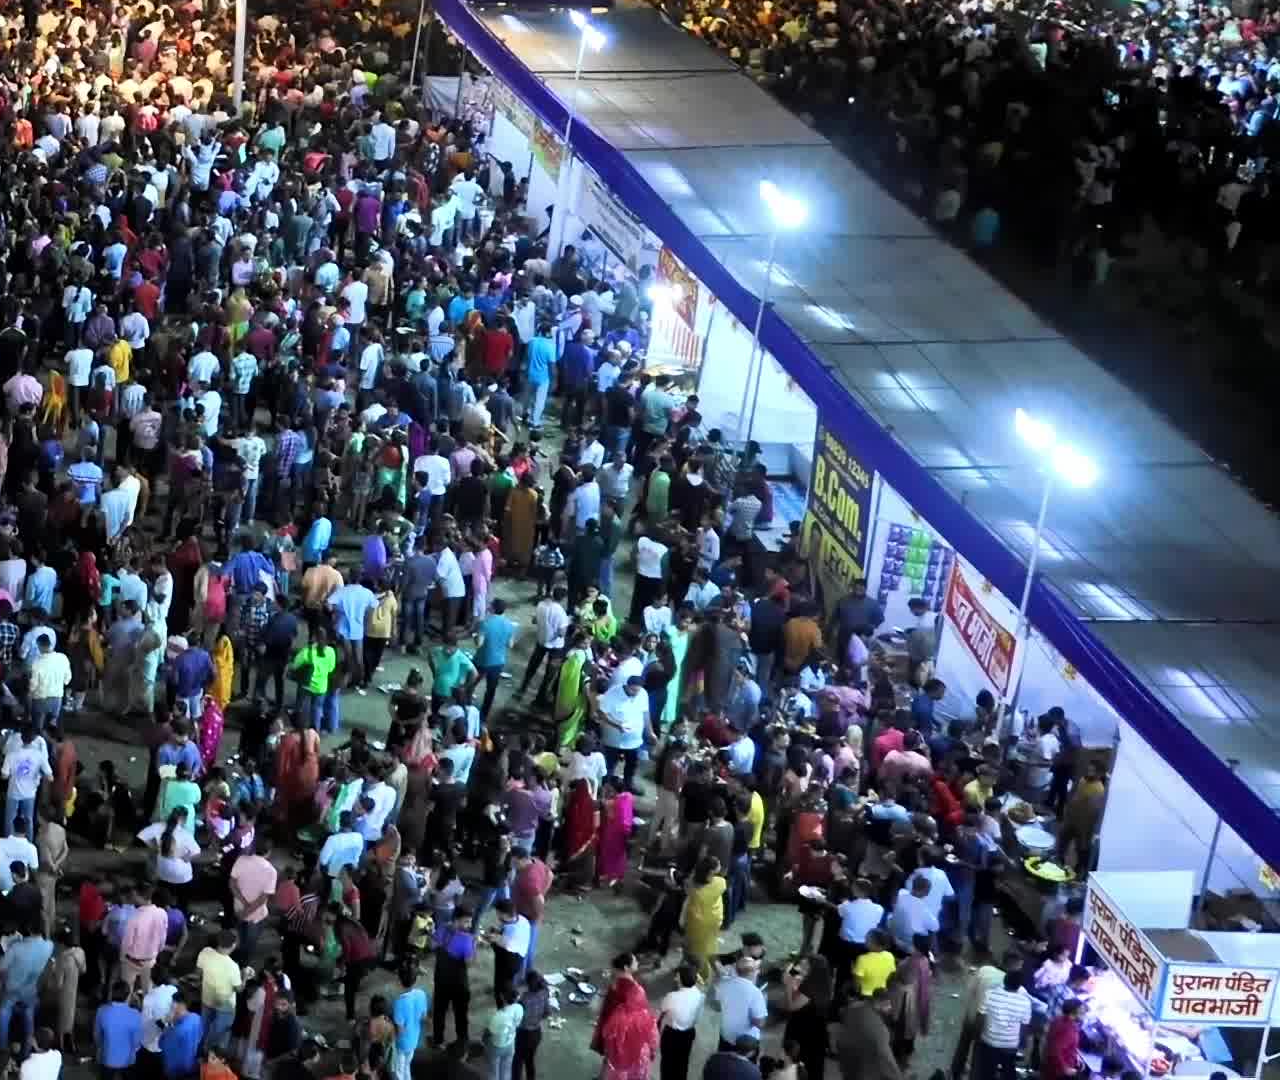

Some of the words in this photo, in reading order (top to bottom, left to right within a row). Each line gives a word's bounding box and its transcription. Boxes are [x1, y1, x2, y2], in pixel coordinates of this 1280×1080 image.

[814, 453, 863, 543] B.Com.
[1090, 888, 1118, 930] पुराना
[1118, 921, 1158, 977] पंडित
[1090, 920, 1153, 1001] पावभाजी
[1170, 994, 1262, 1017] पावभाजी
[1172, 973, 1223, 996] पुराना
[1224, 970, 1272, 994] पंडित
